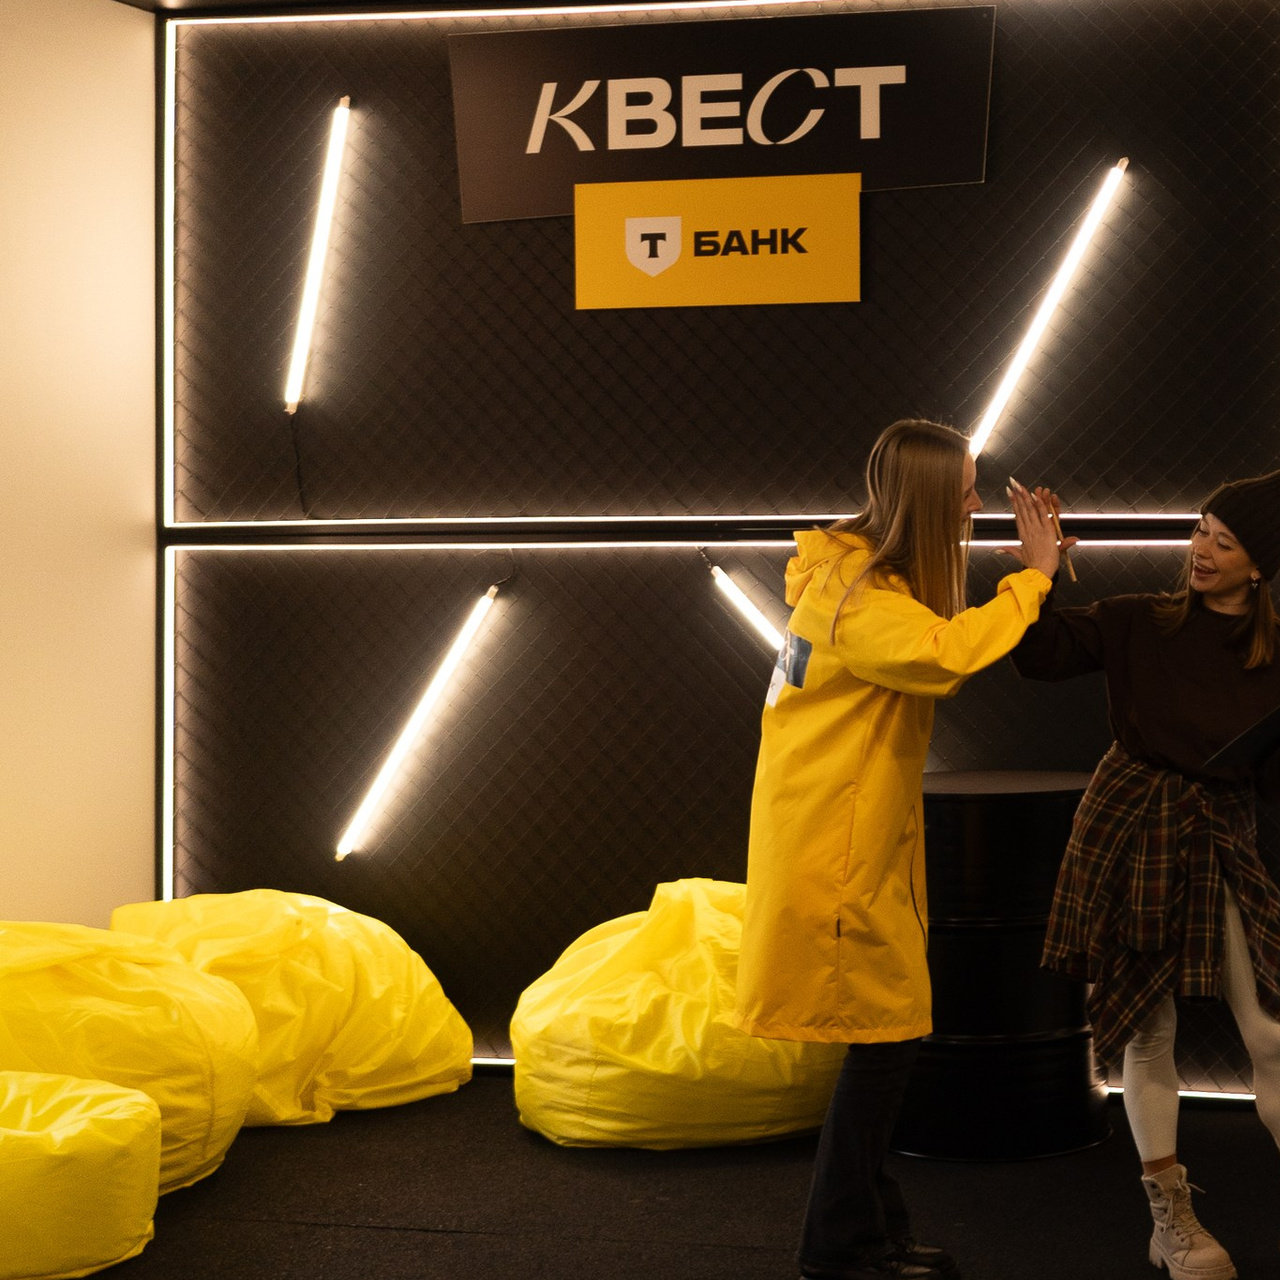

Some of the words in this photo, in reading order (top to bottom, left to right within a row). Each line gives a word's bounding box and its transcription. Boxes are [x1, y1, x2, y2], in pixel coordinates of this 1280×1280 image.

[525, 65, 906, 154] КВЕСТ
[640, 232, 667, 259] Т
[693, 227, 809, 257] БАНК
